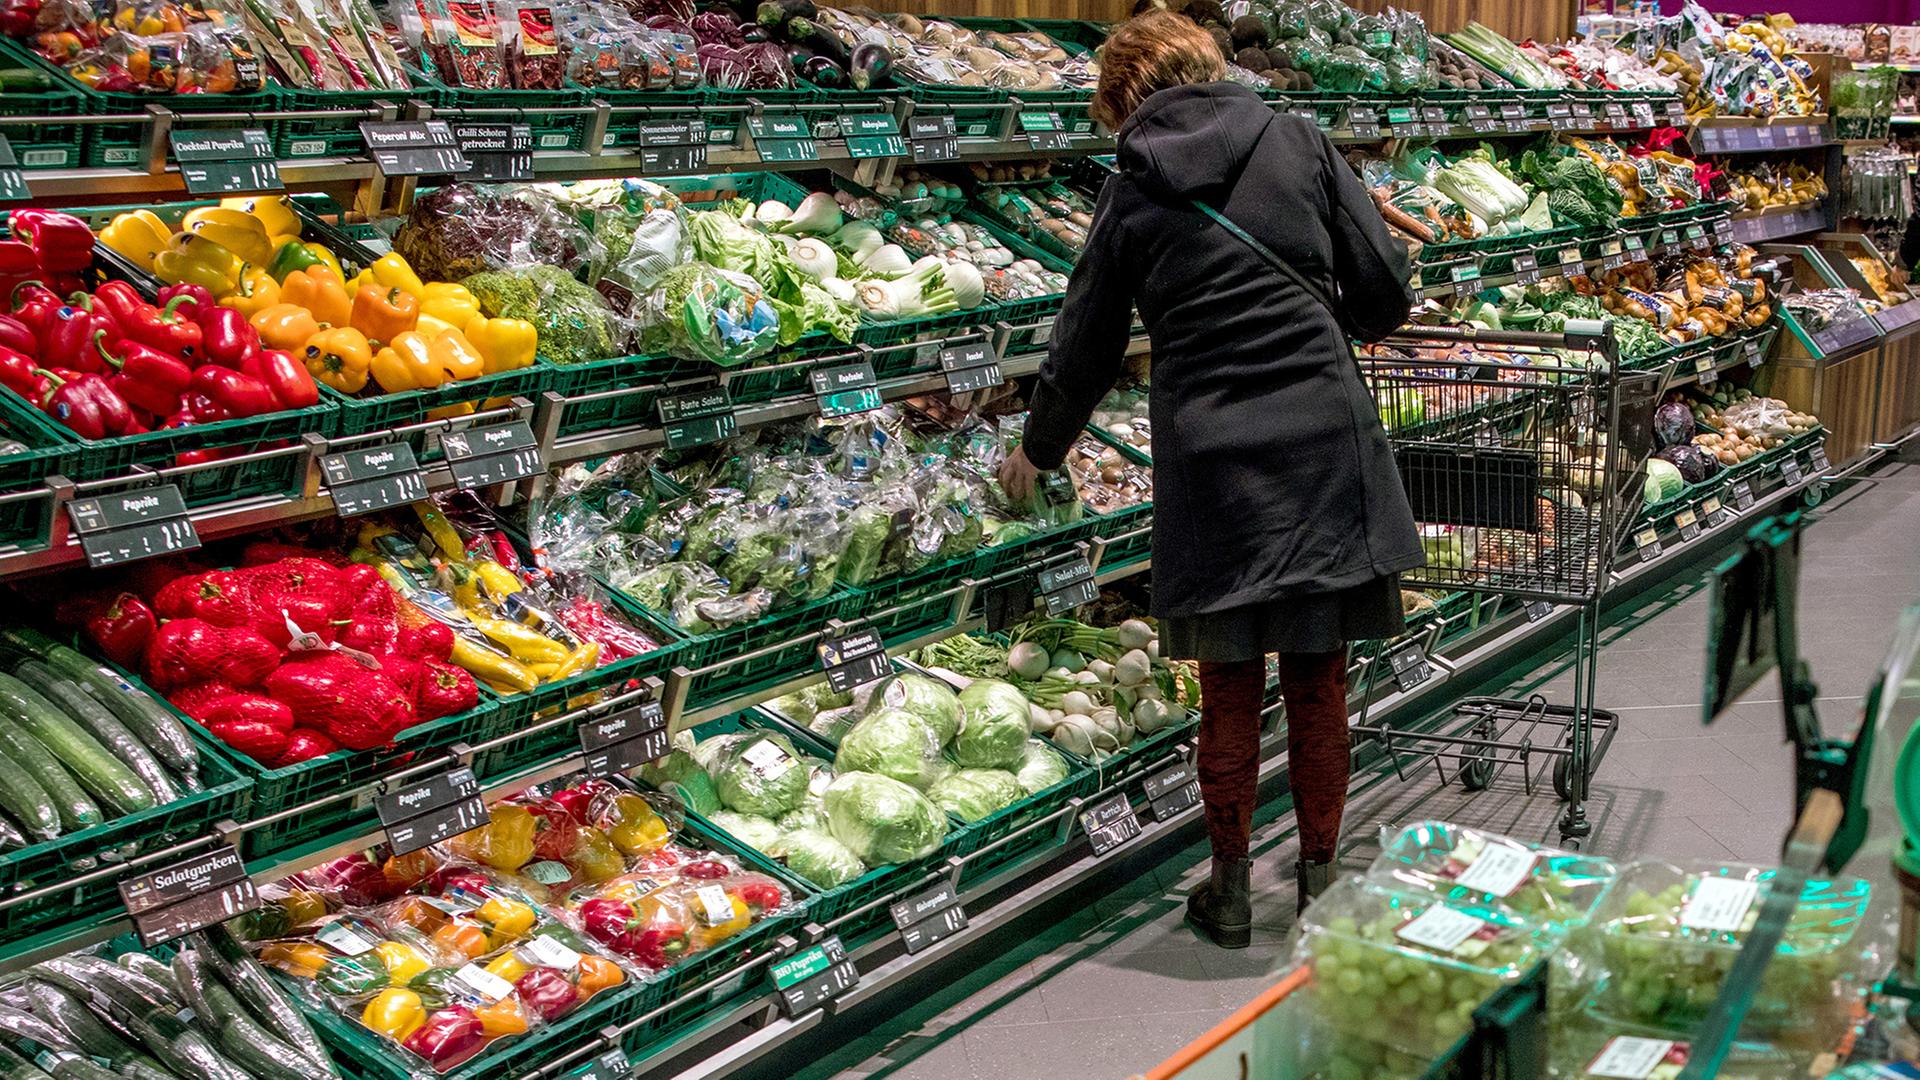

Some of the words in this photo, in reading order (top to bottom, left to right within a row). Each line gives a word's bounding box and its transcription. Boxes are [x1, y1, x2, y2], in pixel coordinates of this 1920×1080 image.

[457, 128, 477, 137] Chilli
[478, 128, 507, 137] Schoten
[641, 123, 687, 134] Sonnenanbeter
[371, 131, 407, 143] Peperoni
[409, 131, 426, 140] Mix
[462, 138, 506, 150] getrocknet
[176, 140, 210, 151] Cocktail
[211, 139, 245, 151] Paprika
[680, 400, 700, 411] Bunte
[701, 396, 724, 407] Salate
[484, 429, 512, 442] Paprika
[364, 451, 395, 466] Paprika
[123, 495, 159, 512] Paprika
[1054, 564, 1089, 583] Salat-Mix
[598, 719, 626, 735] Paprika
[399, 788, 432, 806] Paprika
[1101, 803, 1121, 820] Rettich
[154, 854, 238, 890] Salatgurken
[222, 881, 254, 915] 0.99
[775, 964, 791, 980] BIO
[790, 950, 824, 972] Paprika
